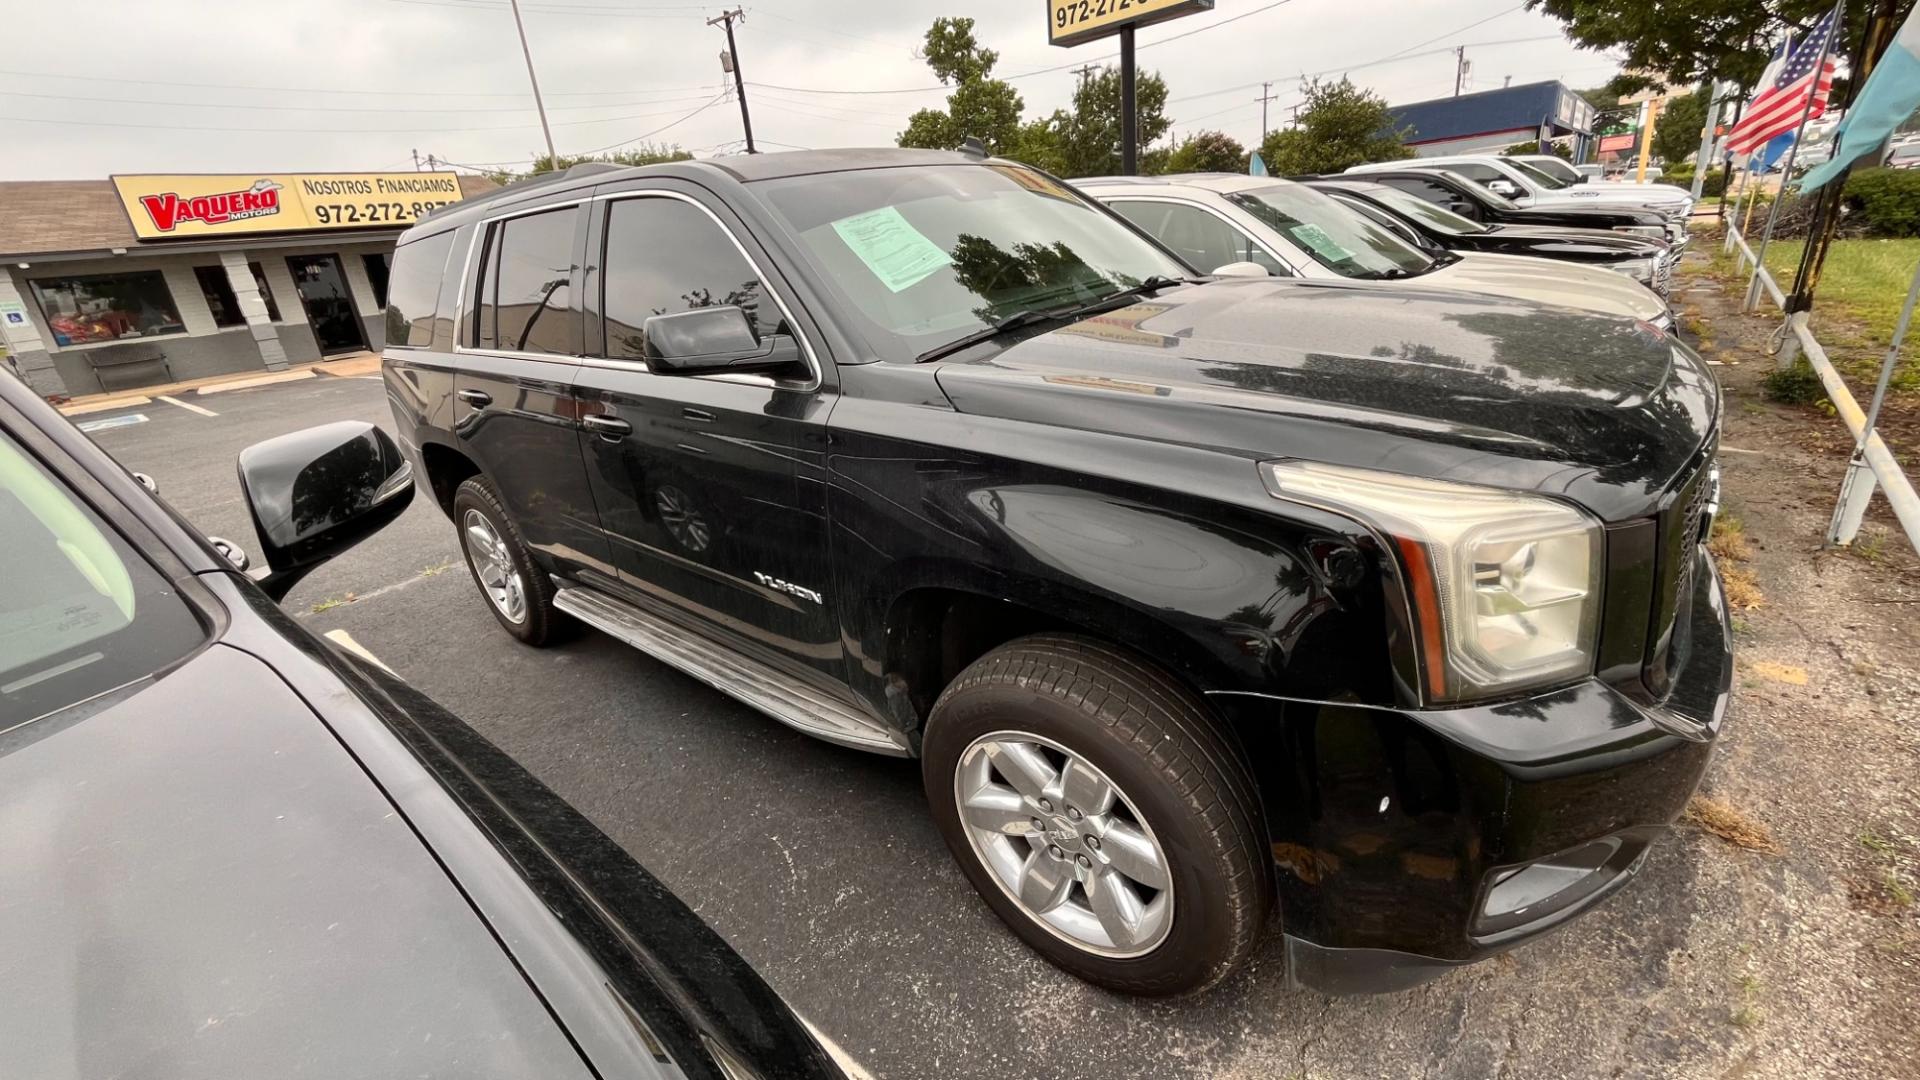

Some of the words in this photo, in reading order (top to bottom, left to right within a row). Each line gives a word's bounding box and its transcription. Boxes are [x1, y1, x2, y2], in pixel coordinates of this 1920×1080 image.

[302, 178, 372, 195] NOSOTROS
[376, 178, 455, 193] FINANCIAMOS
[140, 188, 279, 231] VAQUERO
[230, 208, 278, 220] MOTORS
[753, 570, 823, 605] YUKON
